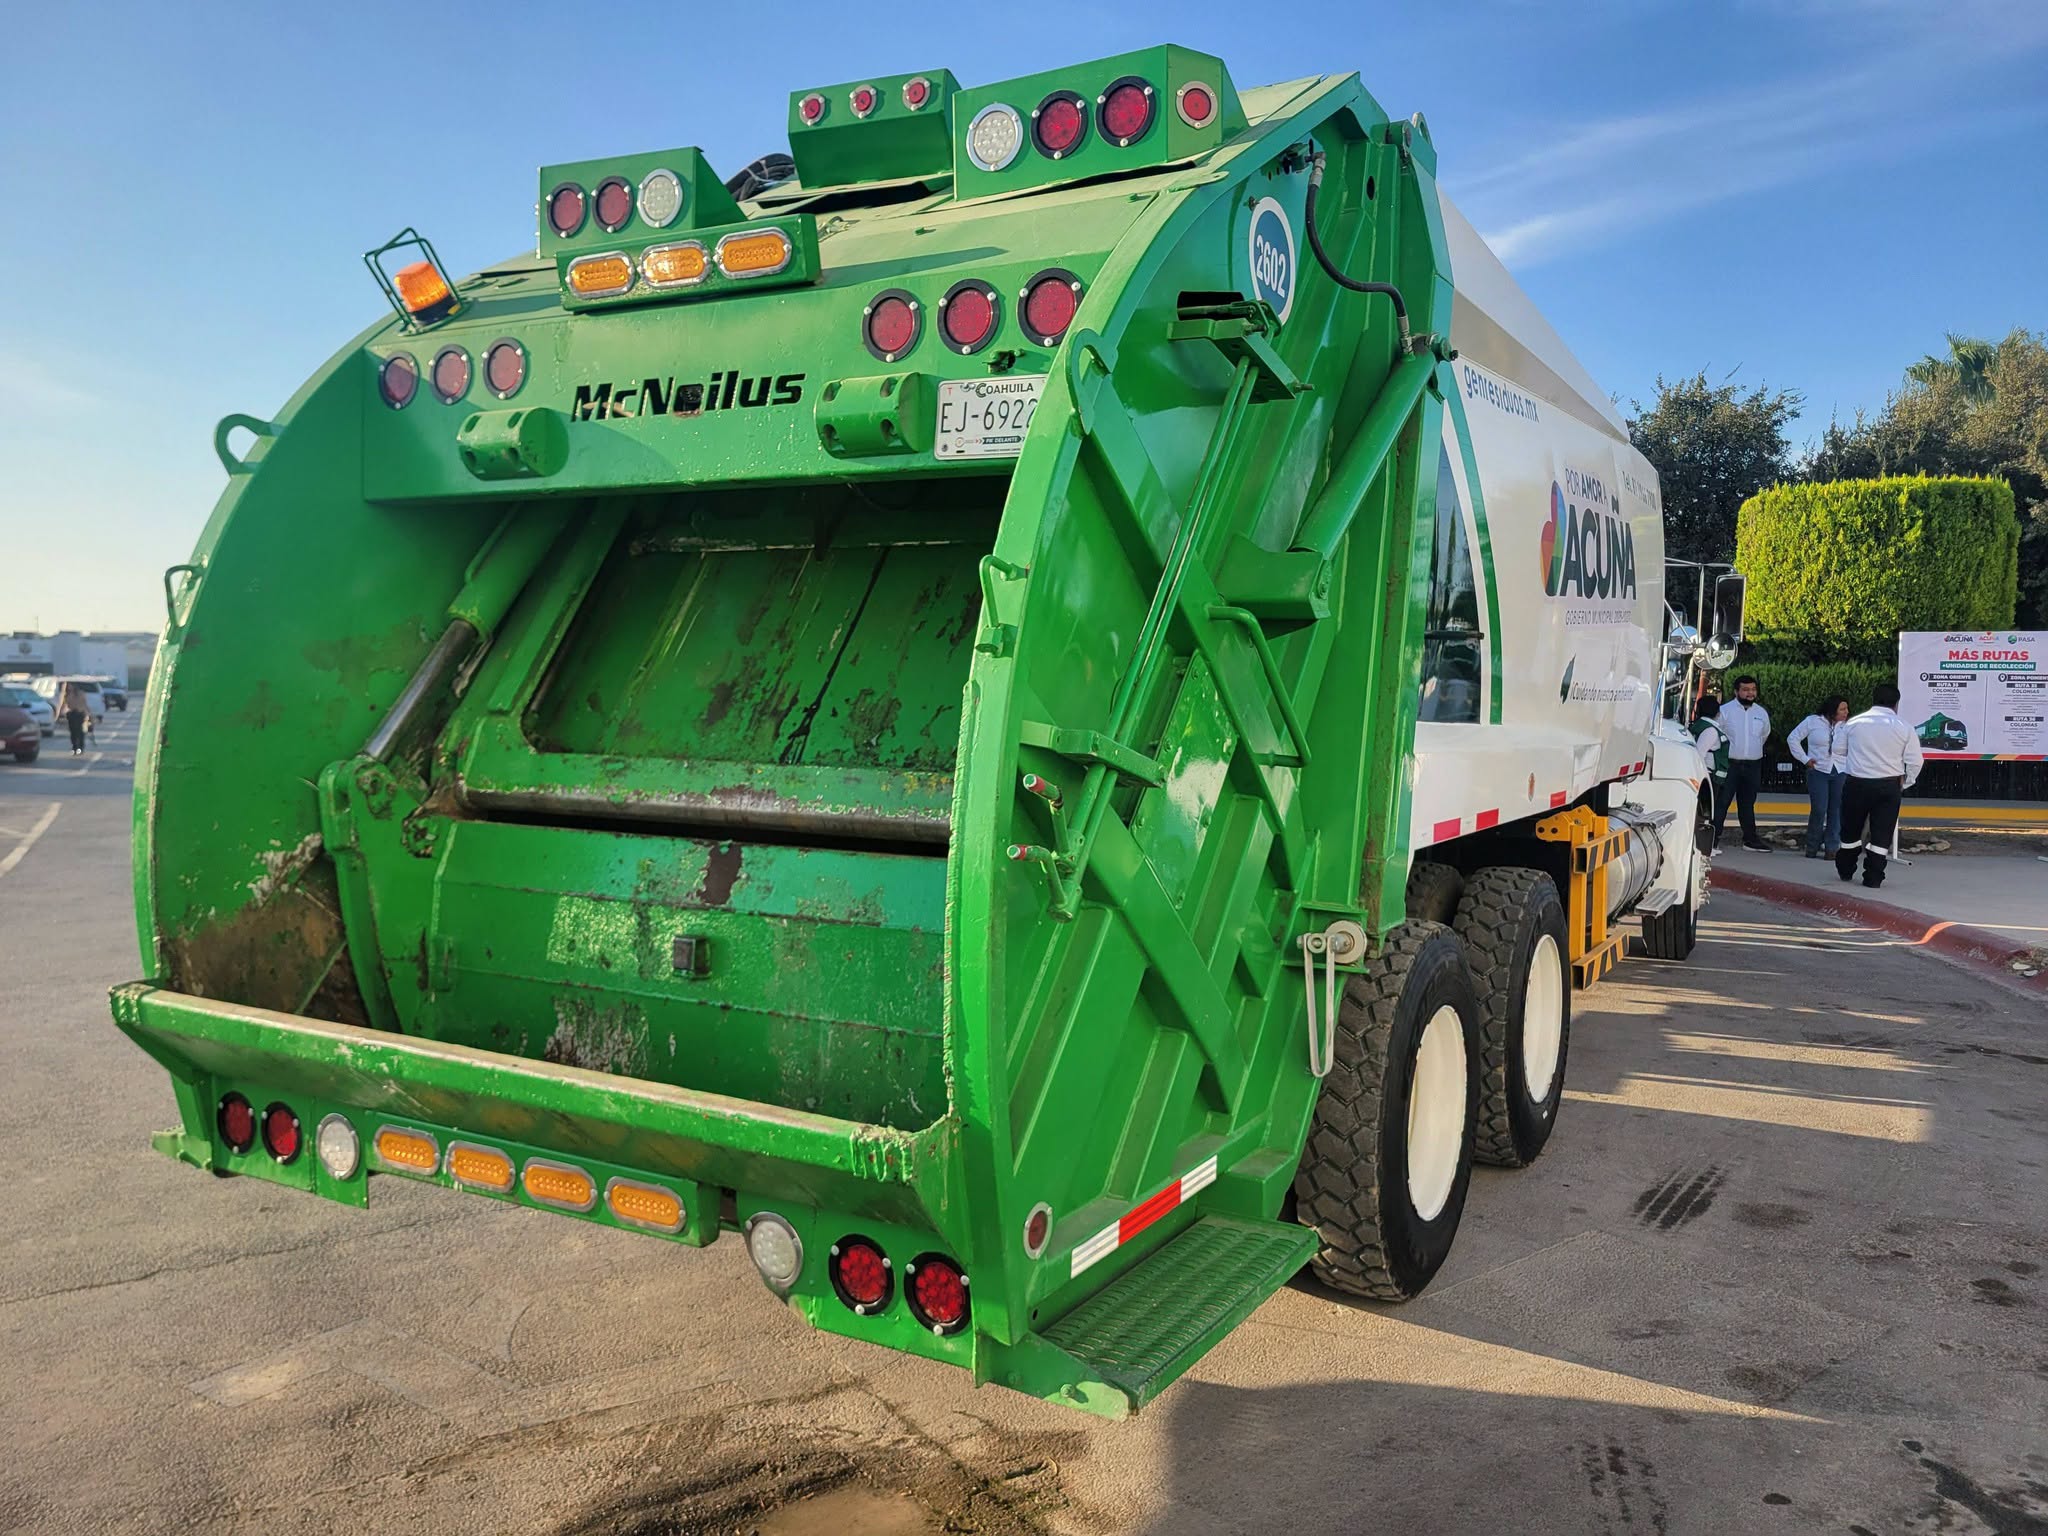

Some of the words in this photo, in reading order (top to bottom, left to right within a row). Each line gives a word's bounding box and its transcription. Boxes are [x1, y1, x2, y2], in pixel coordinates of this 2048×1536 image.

[1256, 234, 1286, 298] 2602
[975, 383, 1034, 398] COAHUILA
[1463, 364, 1539, 423] genresiduos.mx
[1565, 468, 1580, 497] POR
[1581, 472, 1604, 505] AMOR
[1560, 495, 1636, 600] ACUÑA
[1949, 647, 1979, 660] MÁS
[1983, 650, 2029, 661] RUTAS
[1990, 662, 2034, 670] RECOLECCIÓN
